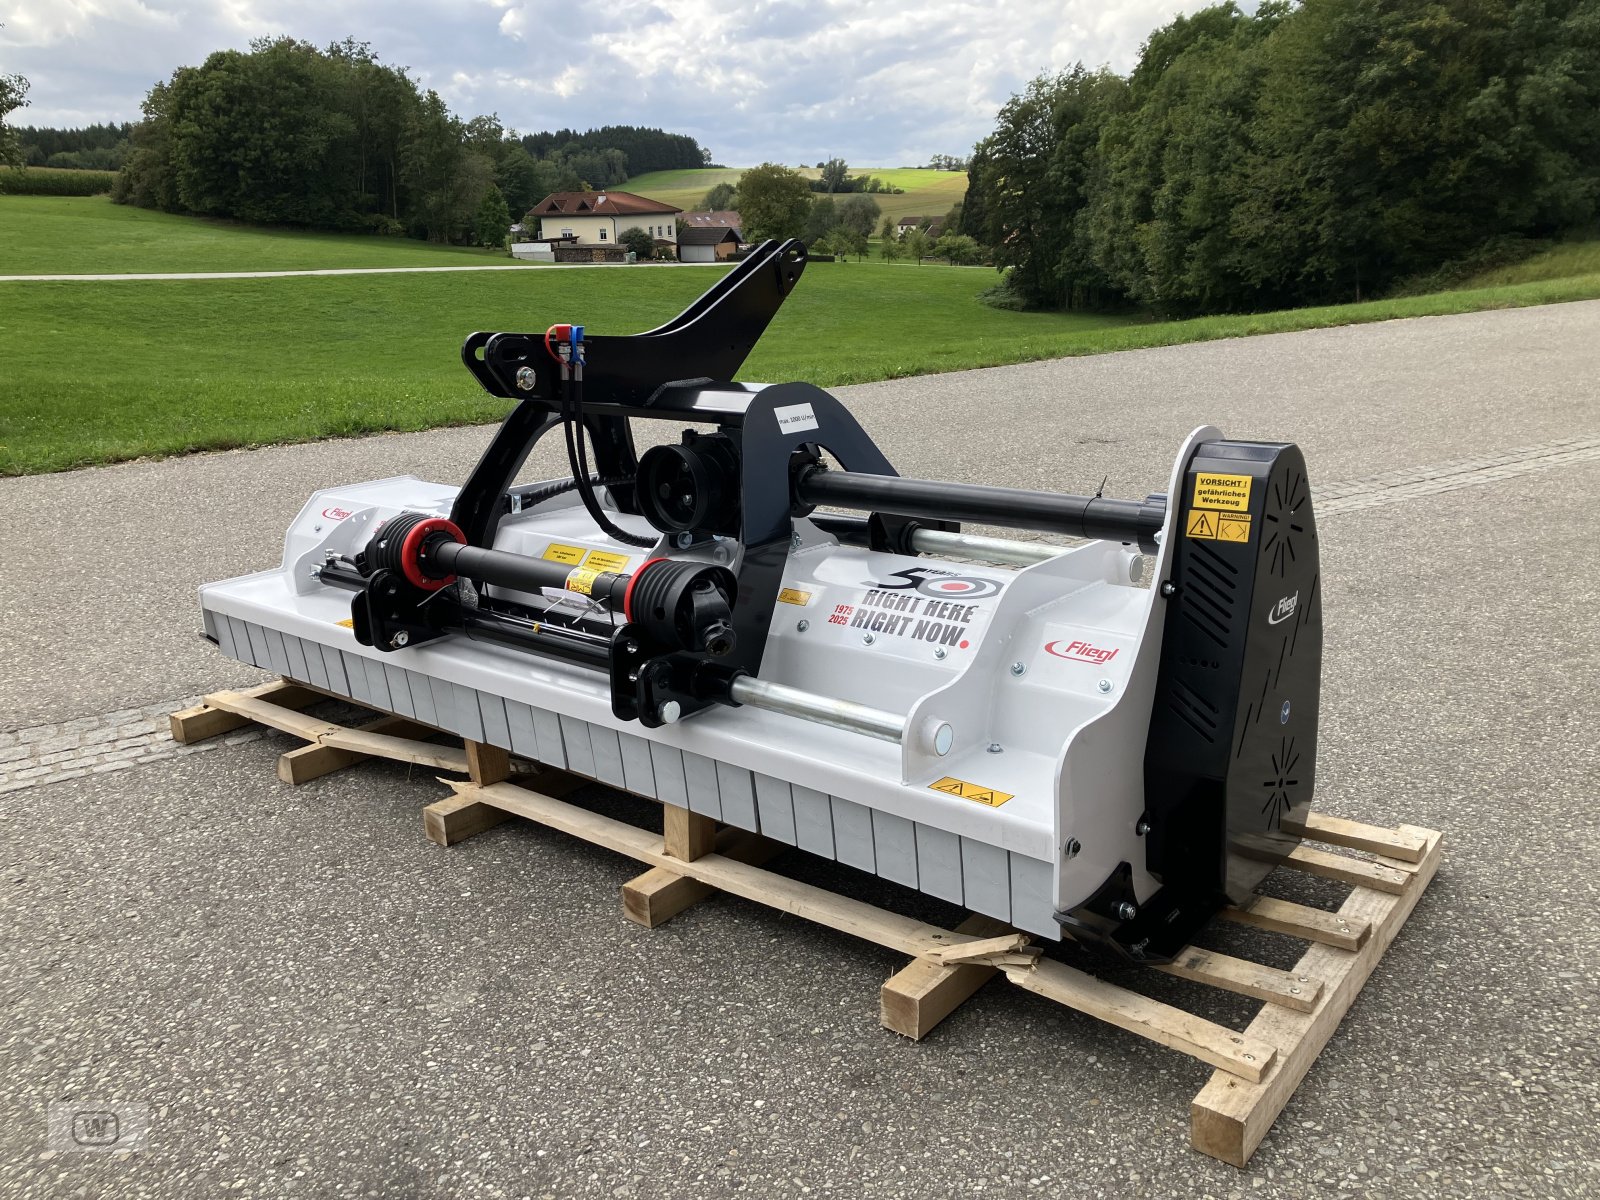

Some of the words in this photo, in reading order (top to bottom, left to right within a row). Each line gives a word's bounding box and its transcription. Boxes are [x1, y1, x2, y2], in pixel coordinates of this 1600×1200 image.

[1200, 478, 1242, 487] VORSICHT
[1198, 488, 1247, 498] gefährliches
[1202, 497, 1240, 506] Werkzeug
[861, 589, 922, 614] RIGHT
[923, 599, 980, 624] HERE
[1277, 590, 1299, 617] Fliegl
[834, 604, 855, 616] 1975
[828, 614, 850, 626] 2025
[850, 608, 913, 637] RIGHT
[1065, 640, 1120, 663] Fliegl
